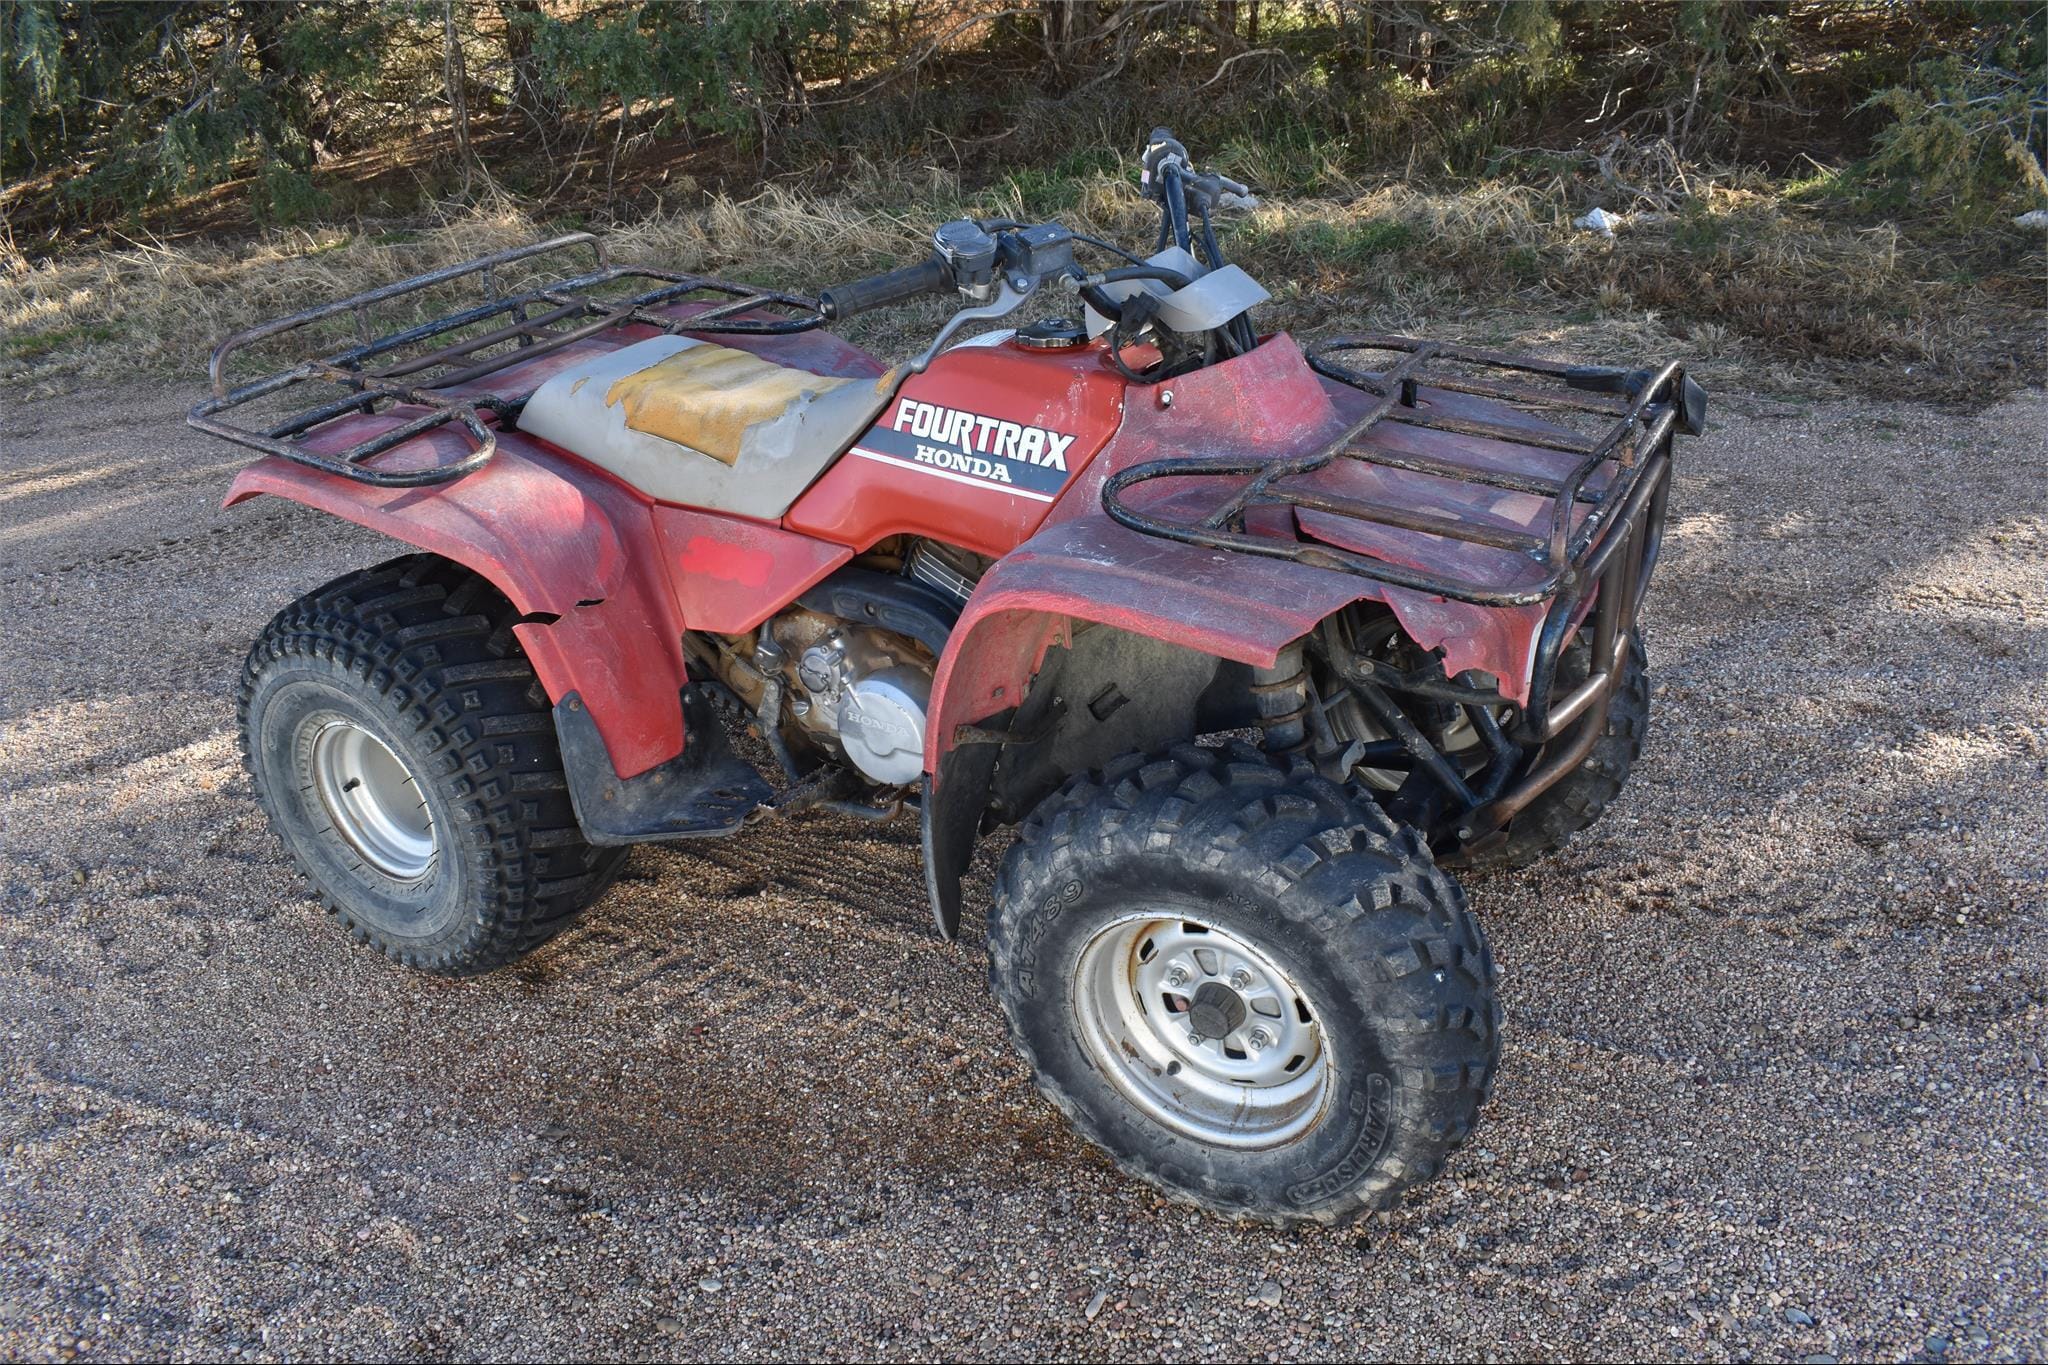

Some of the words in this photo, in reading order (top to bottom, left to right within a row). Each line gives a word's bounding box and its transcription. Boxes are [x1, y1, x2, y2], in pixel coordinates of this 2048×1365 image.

[893, 397, 1077, 472] FOURTRAX
[914, 445, 1012, 483] HONDA
[847, 711, 910, 737] HONDA
[1310, 1096, 1391, 1197] CARLISLE
